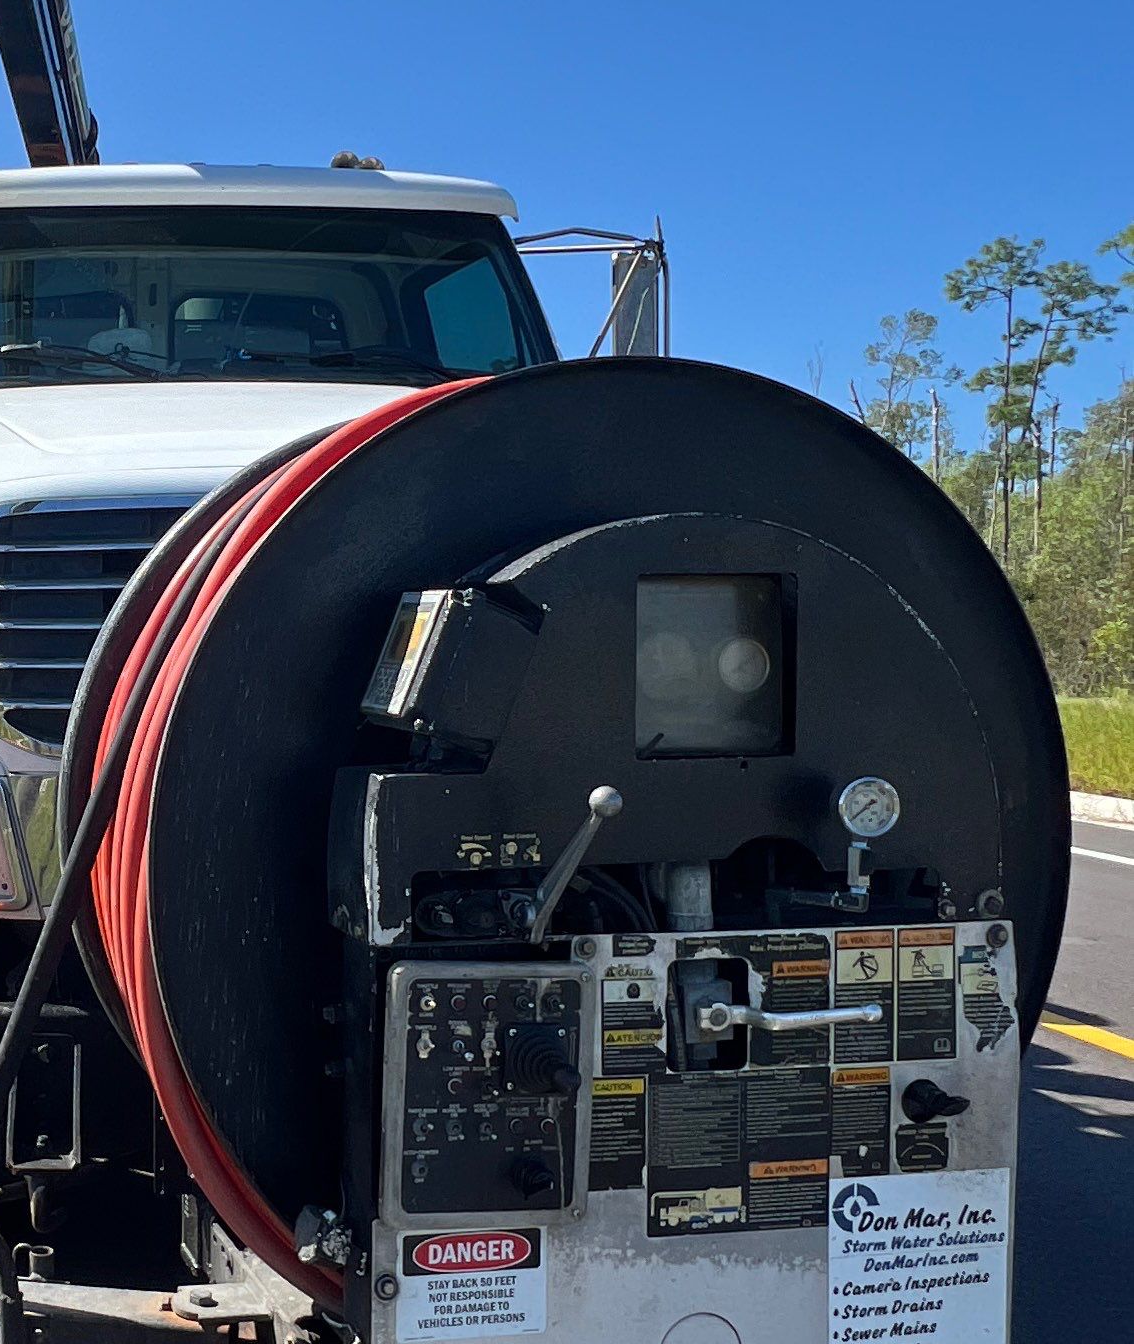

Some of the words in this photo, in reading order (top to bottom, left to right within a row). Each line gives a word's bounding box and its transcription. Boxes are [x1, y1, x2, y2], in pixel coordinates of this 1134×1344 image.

[594, 1082, 634, 1092] CAUTION
[845, 1071, 887, 1082] WARNING
[858, 1210, 899, 1233] Don
[903, 1207, 951, 1230] Mar,
[958, 1203, 996, 1226] Inc.
[427, 1239, 515, 1265] DANGER
[842, 1238, 887, 1254] Storm
[891, 1235, 935, 1250] Water
[936, 1229, 1006, 1247] Solutions
[863, 1251, 980, 1273] DonMarInc.com
[427, 1278, 450, 1291] STAY
[452, 1277, 479, 1289] BACK
[480, 1276, 493, 1287] 50
[495, 1275, 517, 1286] FEET
[842, 1279, 902, 1296] Camera
[905, 1270, 990, 1293] Inspections
[428, 1293, 448, 1303] NOT
[450, 1288, 515, 1302] RESPONSIBLE
[434, 1305, 453, 1316] FOR
[454, 1302, 496, 1314] DAMAGE
[498, 1301, 510, 1311] TO
[841, 1304, 888, 1320] Storm
[891, 1298, 944, 1315] Drains
[417, 1316, 464, 1329] VEHICLES
[465, 1315, 480, 1326] OR
[481, 1312, 526, 1325] PERSONS
[841, 1327, 888, 1342] Sewer
[889, 1321, 938, 1338] Mains
